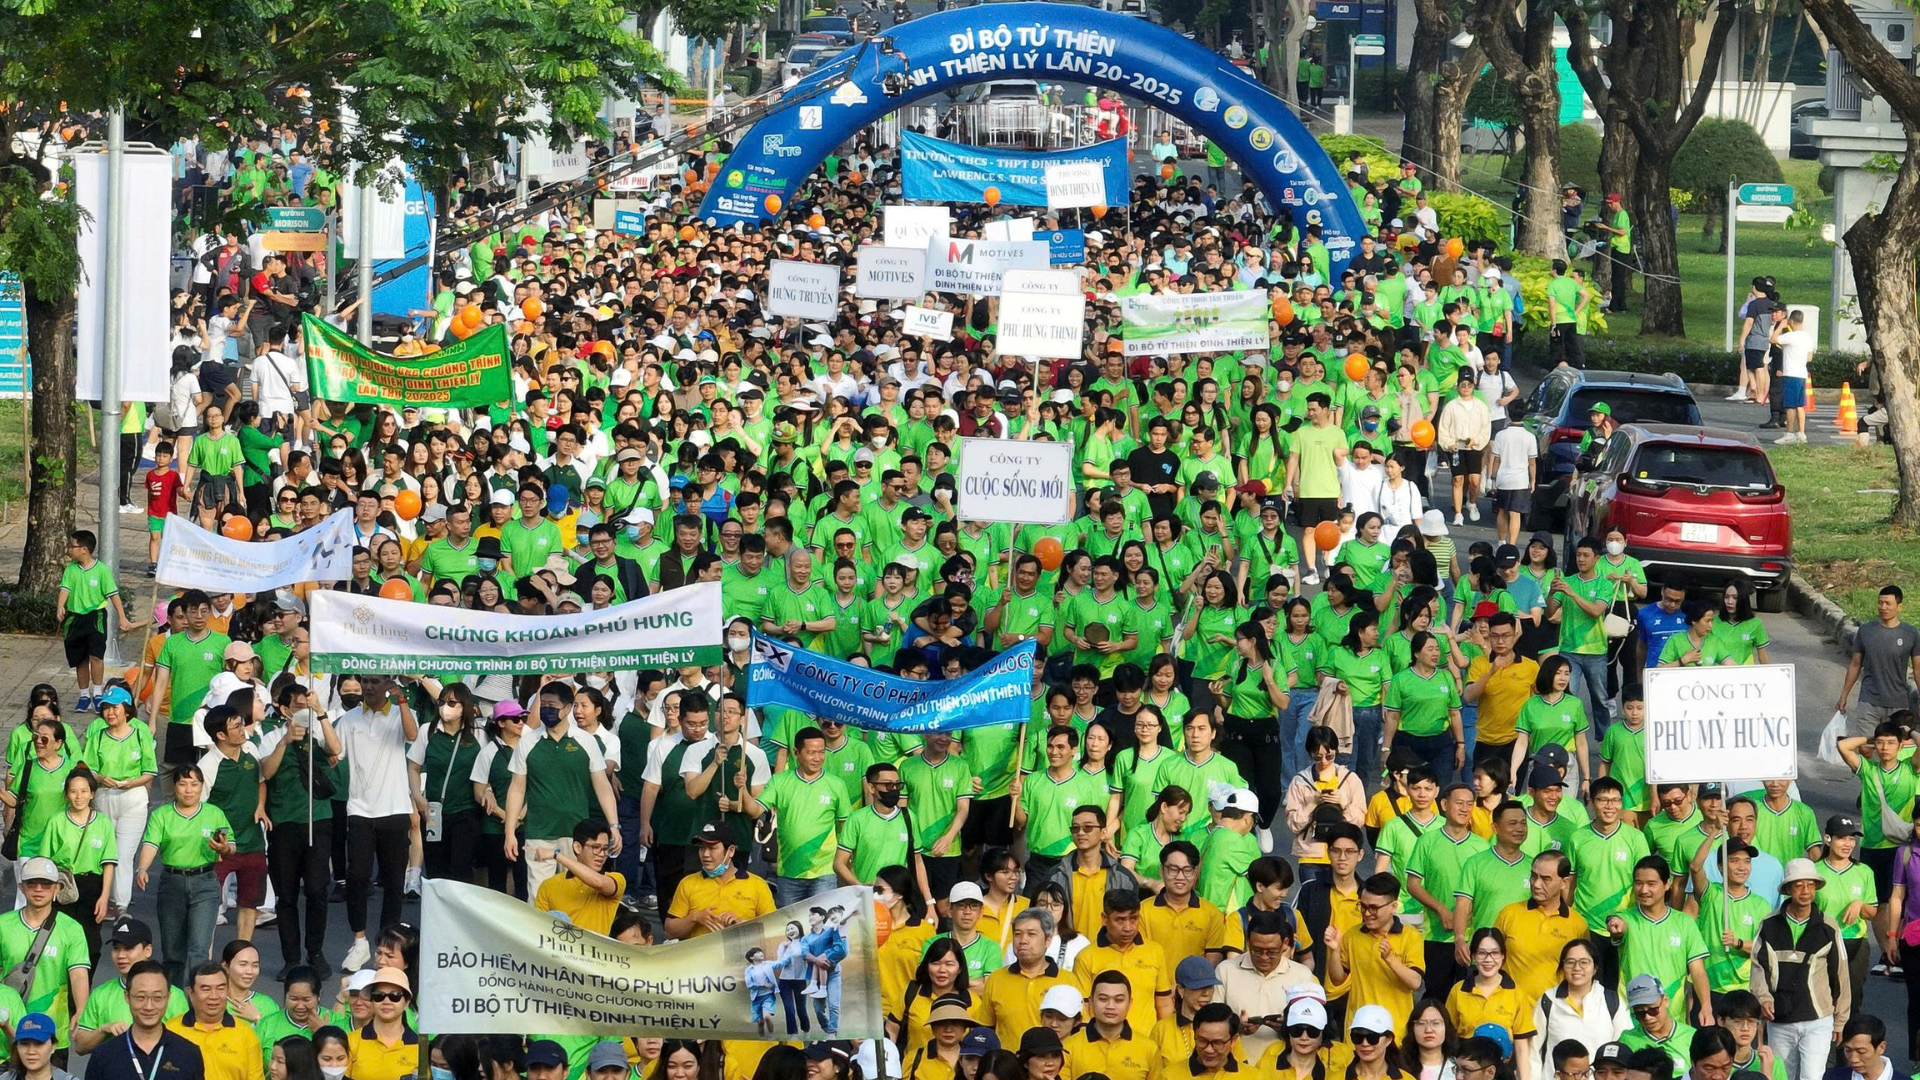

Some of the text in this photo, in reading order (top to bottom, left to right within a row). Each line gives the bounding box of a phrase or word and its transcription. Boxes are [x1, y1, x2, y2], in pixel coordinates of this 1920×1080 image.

[1332, 5, 1349, 13] ACB
[949, 22, 1116, 58] ĐI BỘ TỪ THIỆN
[940, 52, 1006, 78] THIỆN
[1012, 49, 1040, 70] LÝ
[1097, 61, 1183, 106] 20-2025
[905, 149, 956, 164] TRƯỜNG
[958, 155, 988, 167] THCS
[997, 157, 1028, 169] THPT
[933, 169, 995, 181] LAWRENCE
[997, 173, 1006, 183] S.
[1009, 174, 1038, 185] TING
[274, 219, 309, 228] MORISON
[980, 249, 1024, 258] MOTIVES
[875, 257, 908, 267] CÔNG TY
[787, 274, 822, 285] CÔNG TY
[868, 271, 915, 284] MOTIVES
[935, 268, 944, 277] ĐI
[946, 267, 959, 279] BỘ
[935, 279, 956, 289] ĐINH
[1021, 279, 1060, 291] CÔNG TY
[772, 285, 798, 300] HƯNG
[1021, 304, 1062, 315] CÔNG TY
[919, 314, 937, 324] IVB
[1003, 319, 1020, 338] PHÚ
[1129, 342, 1139, 351] ĐI
[1141, 340, 1154, 352] BỘ
[1200, 338, 1224, 347] ĐINH
[1226, 335, 1252, 347] THIỆN
[1254, 335, 1266, 345] LÝ
[469, 353, 501, 370] TRÌNH
[405, 390, 450, 402] 20/2025
[990, 452, 1042, 466] CÔNG TY
[965, 469, 1063, 501] CUỘC SỐNG MỚI
[214, 551, 237, 566] FUND
[425, 625, 499, 643] CHỨNG
[505, 626, 578, 643] KHOÁN
[585, 616, 628, 635] PHÚ
[633, 610, 693, 631] HƯNG
[342, 647, 696, 672] ĐỒNG HÀNH CHƯƠNG TRÌNH ĐI BỘ TỪ THIỆN ĐINH THIỆN LÝ
[795, 662, 839, 688] CÔNG
[841, 675, 861, 694] TY
[862, 679, 888, 700] CỔ
[1677, 680, 1766, 701] CÔNG TY
[808, 689, 855, 713] CHƯƠNG
[856, 705, 889, 723] TRÌNH
[1654, 710, 1790, 751] PHÚ MỸ HƯNG
[844, 762, 855, 772] 20
[943, 778, 954, 788] 20
[819, 795, 831, 805] 20
[1064, 797, 1077, 808] 20
[1551, 840, 1561, 850] 20
[1615, 851, 1628, 862] 20
[1670, 936, 1681, 947] 20
[437, 946, 736, 995] BẢO HIỂM NHÂN THỌ PHÚ HƯNG
[969, 959, 981, 969] 20
[518, 979, 554, 994] HÀNH
[556, 986, 593, 1002] CÙNG
[595, 993, 653, 1009] CHƯƠNG
[655, 998, 695, 1011] TRÌNH
[452, 992, 721, 1030] ĐI BỘ TỪ THIỆN ĐINH THIỆN LÝ
